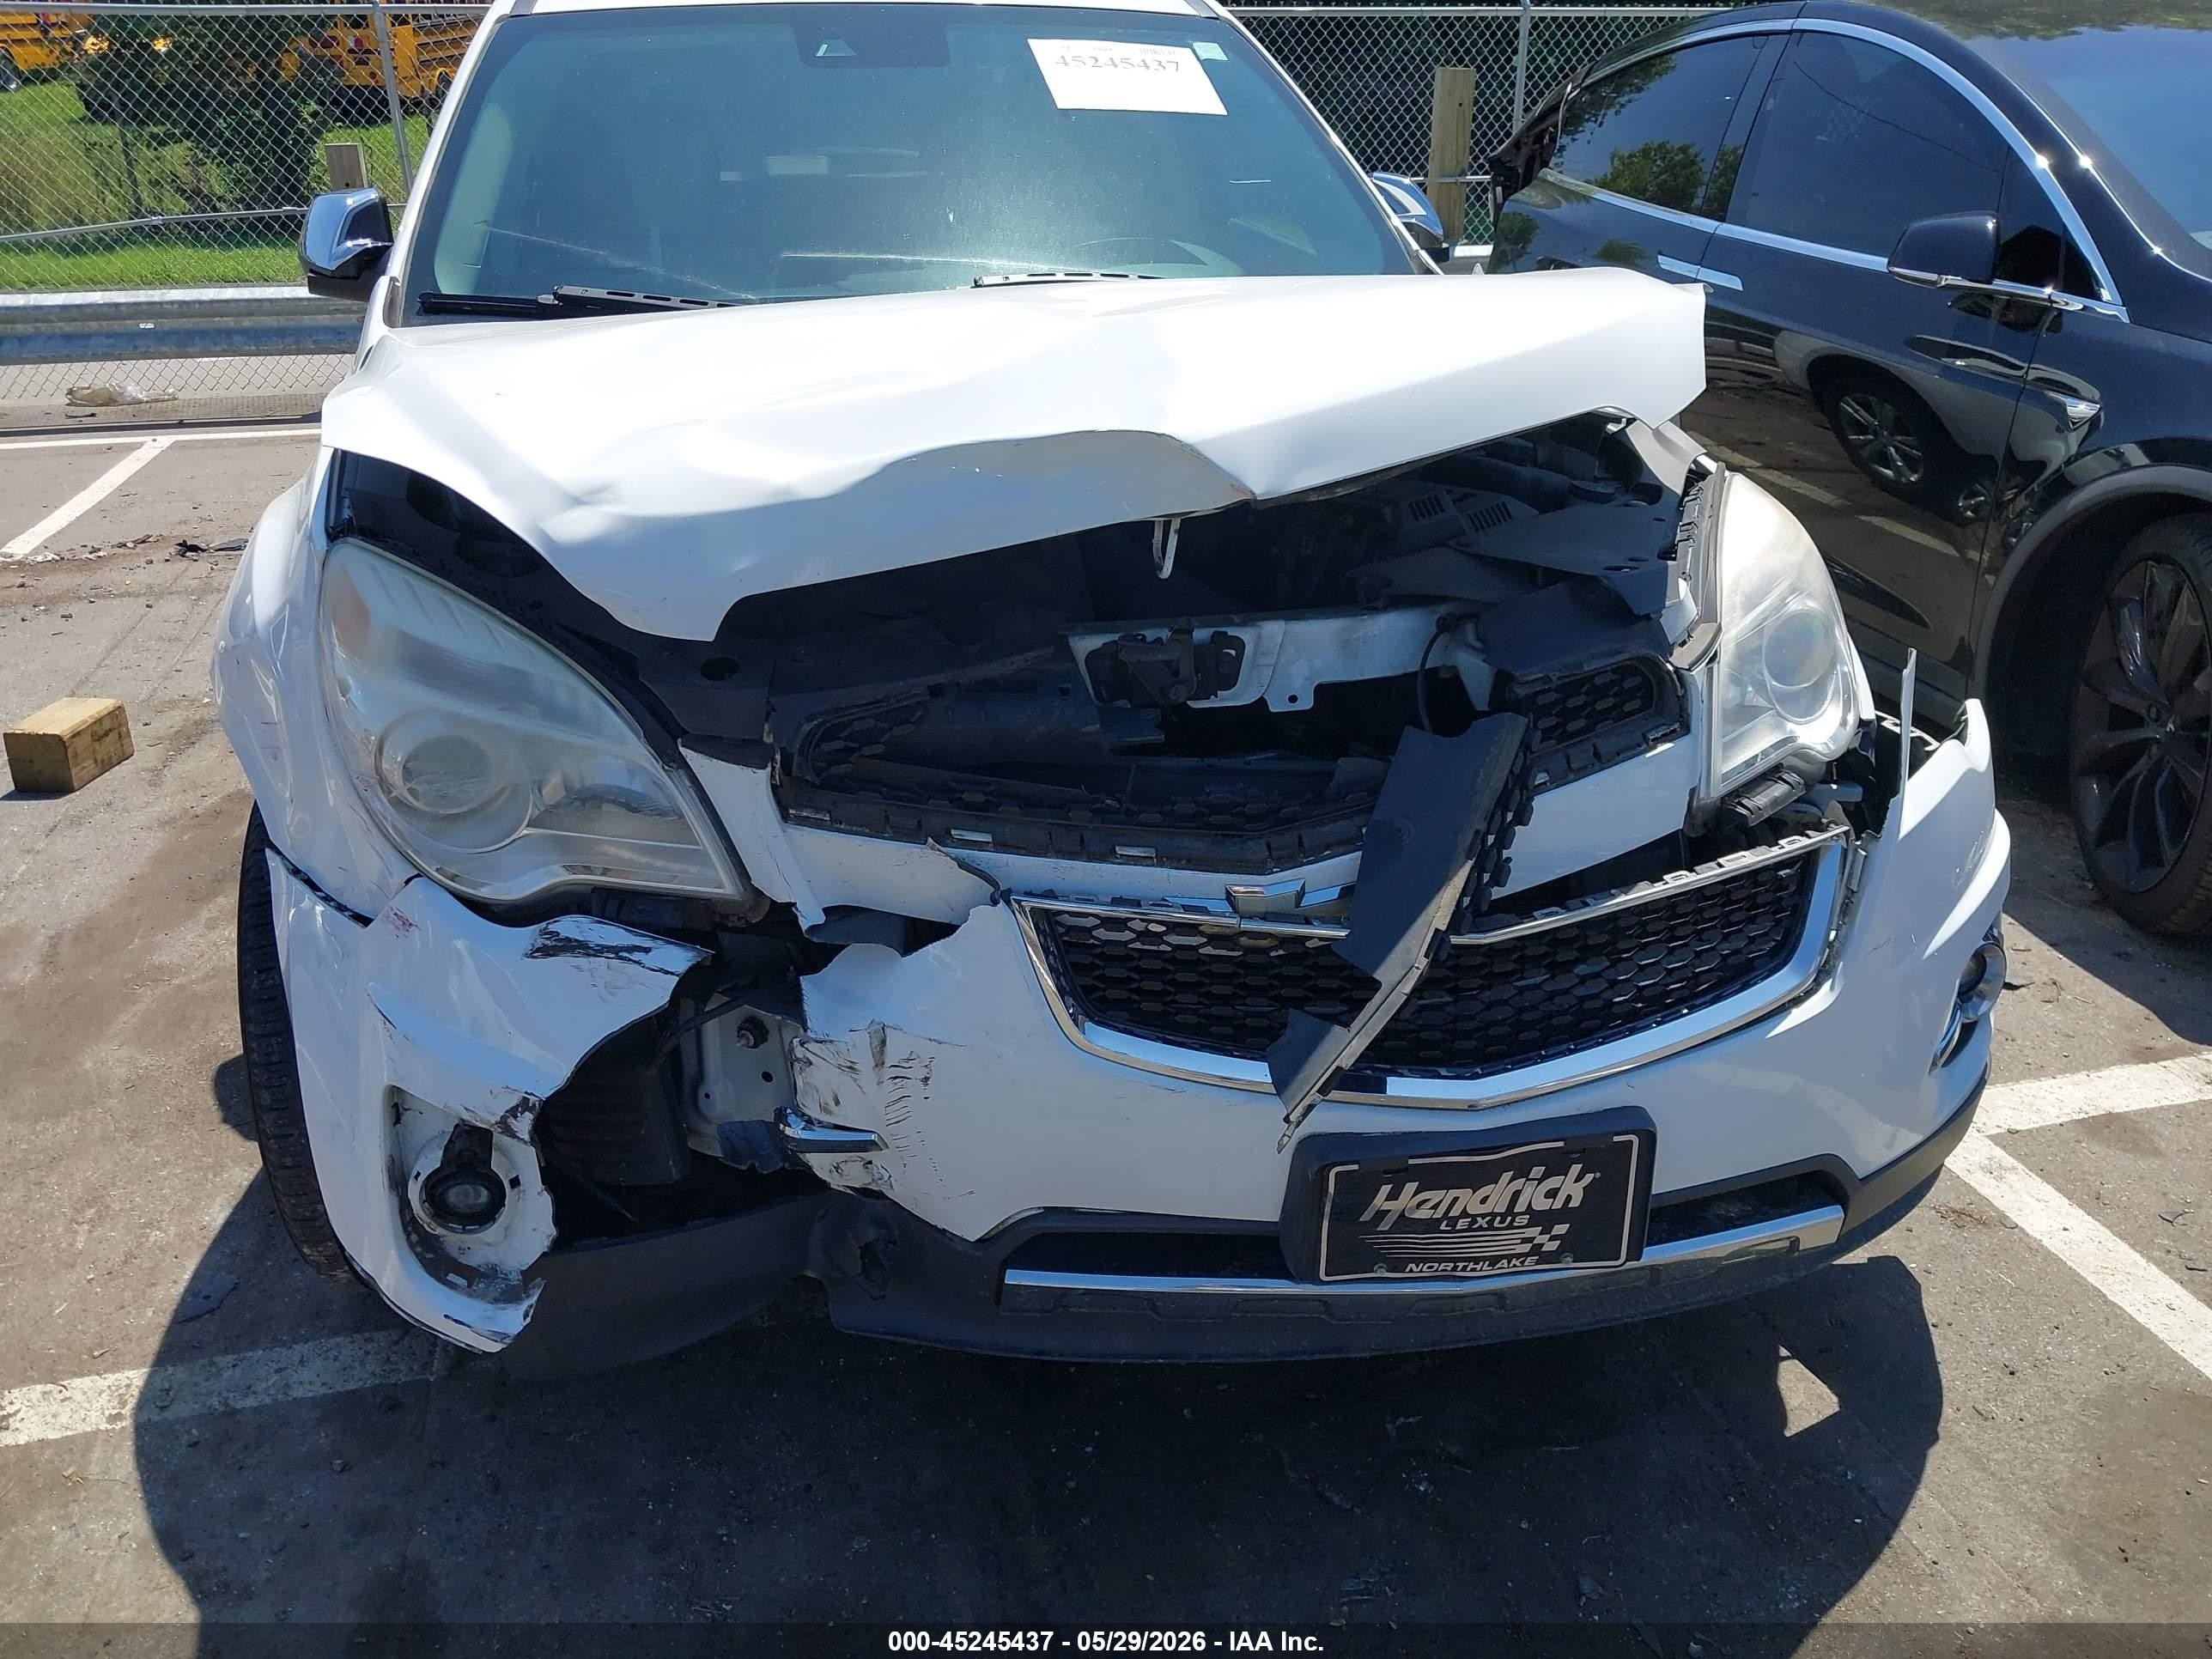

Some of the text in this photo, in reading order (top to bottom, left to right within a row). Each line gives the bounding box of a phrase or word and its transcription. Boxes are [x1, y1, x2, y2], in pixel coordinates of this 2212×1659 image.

[1054, 55, 1180, 73] 45245437
[1359, 1164, 1595, 1231] Hendrick
[1440, 1214, 1530, 1231] LEXUS
[1404, 1255, 1540, 1273] NORTHLAKE
